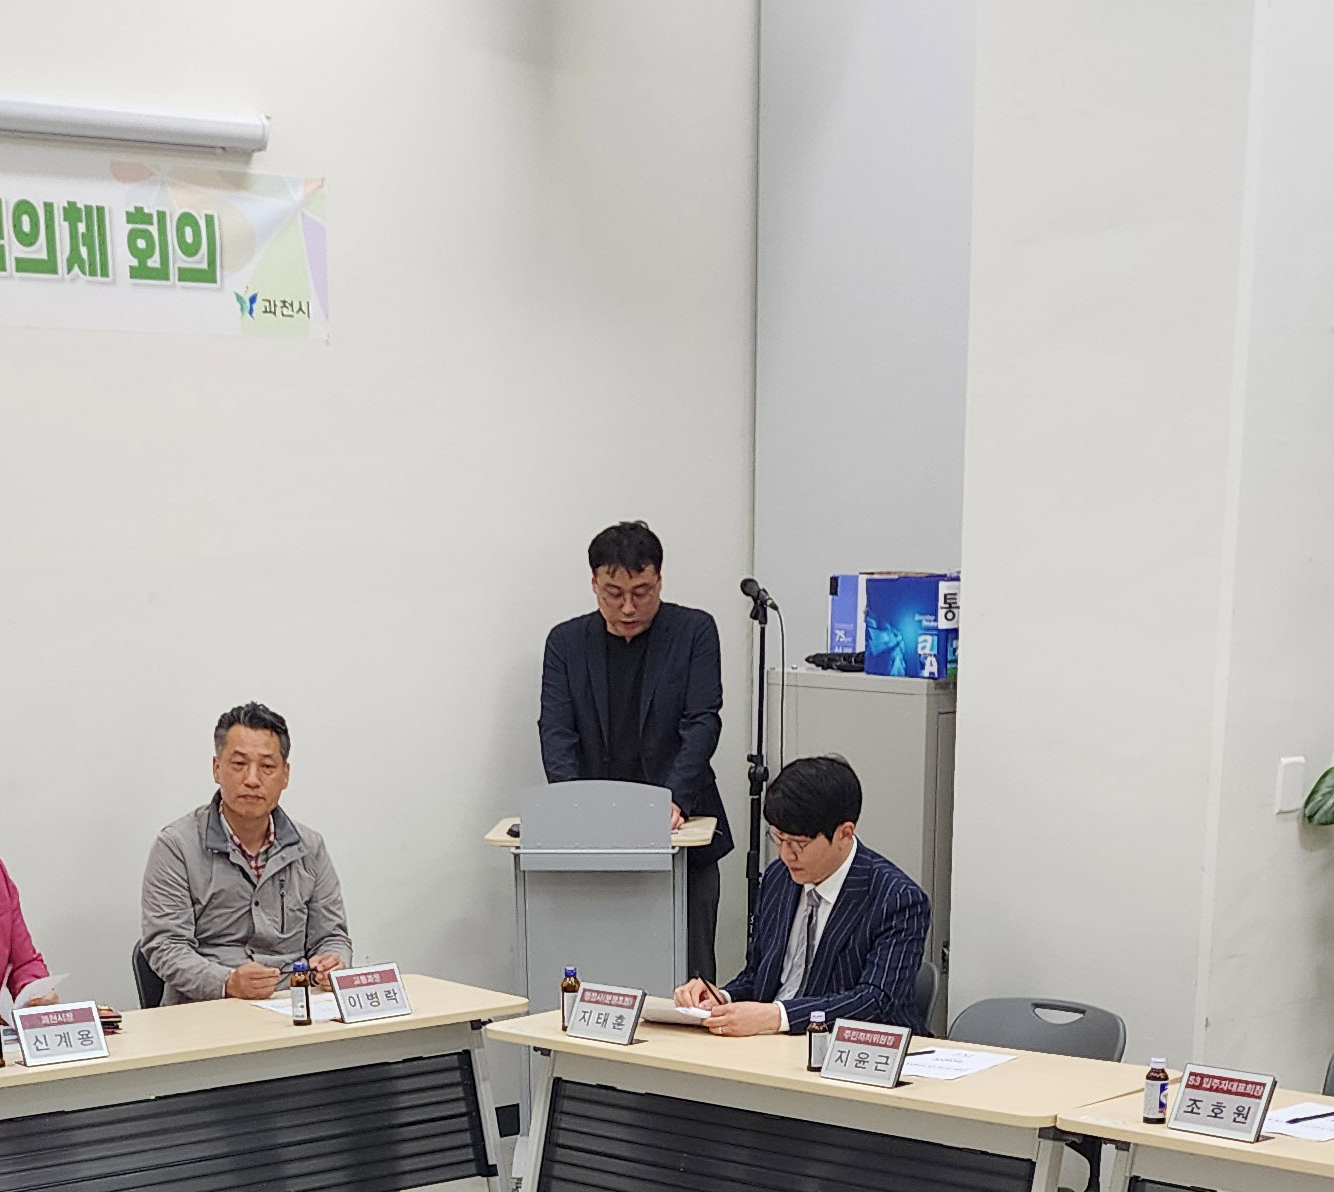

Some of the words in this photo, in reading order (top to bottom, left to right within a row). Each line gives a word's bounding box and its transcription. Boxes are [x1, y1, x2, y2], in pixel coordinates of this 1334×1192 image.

[124, 205, 219, 286] 회의
[262, 298, 311, 319] 과천시
[940, 592, 960, 622] 통
[578, 1009, 626, 1031] 지태훈
[33, 1028, 95, 1052] 신계용
[843, 1029, 895, 1046] 주민자치위원장
[834, 1049, 891, 1073] 지윤근
[1188, 1075, 1201, 1086] S3
[1202, 1078, 1264, 1097] 입주자대표회장
[1183, 1097, 1251, 1125] 조호원
